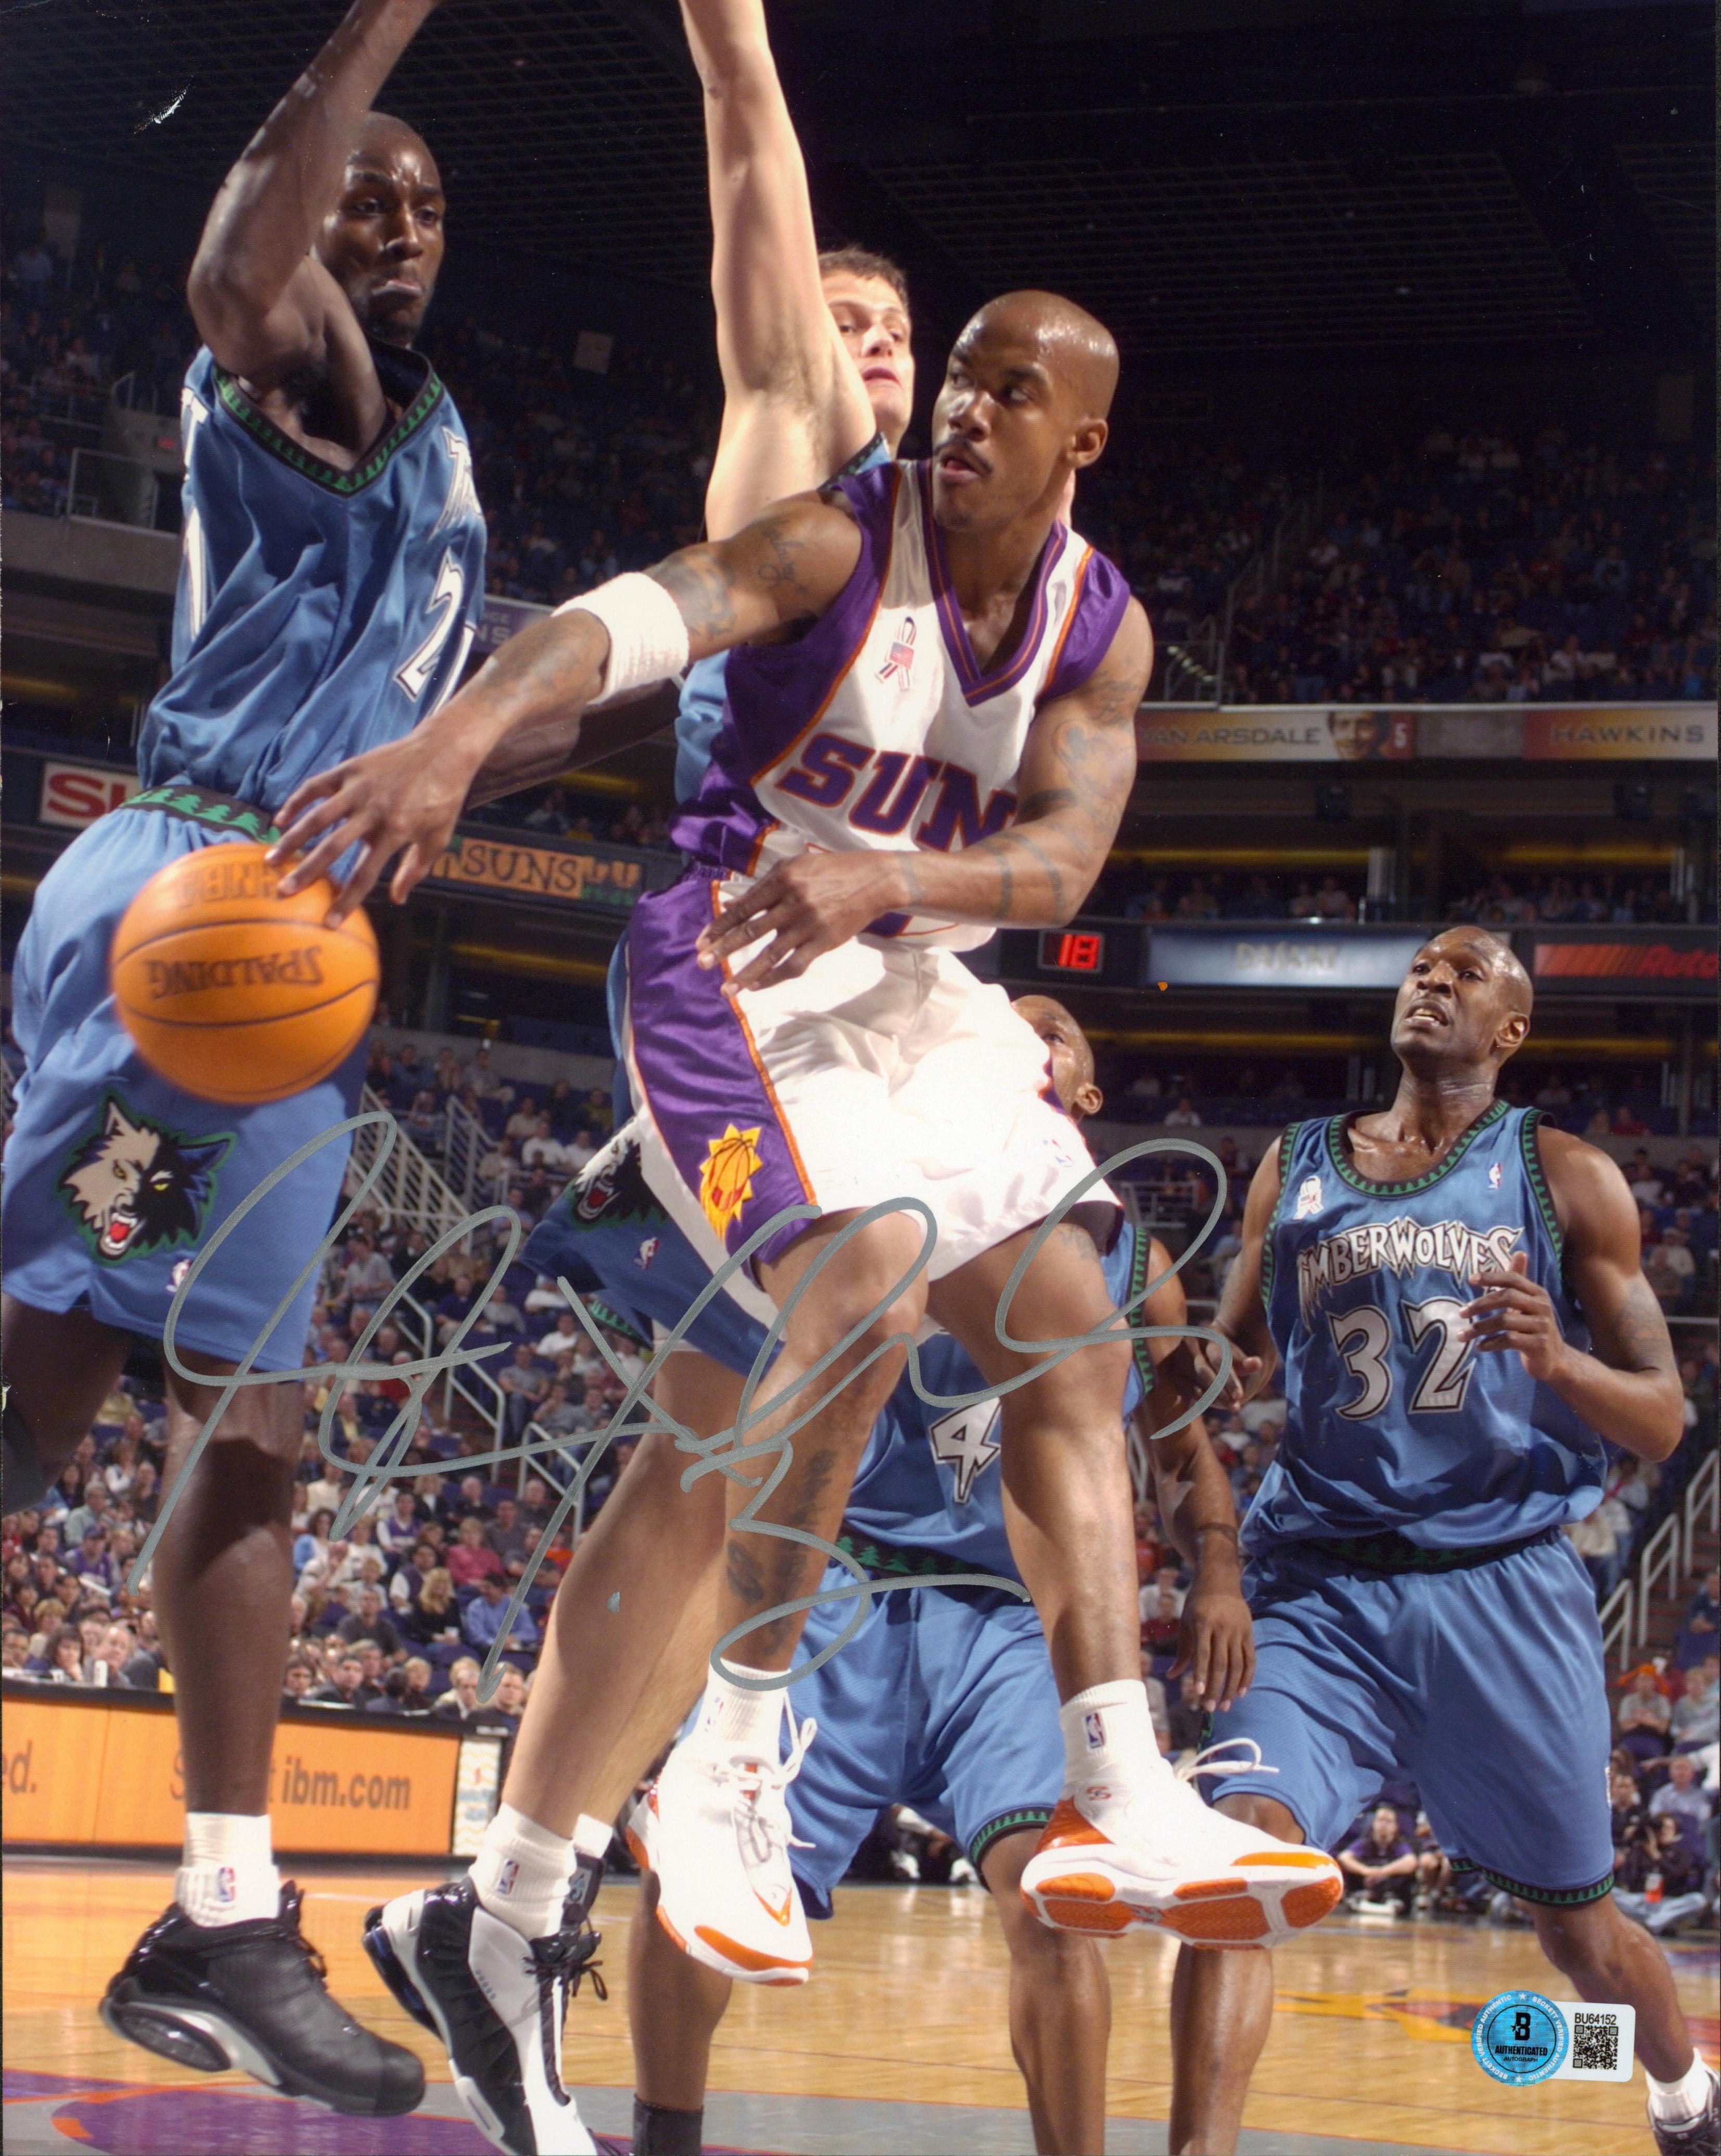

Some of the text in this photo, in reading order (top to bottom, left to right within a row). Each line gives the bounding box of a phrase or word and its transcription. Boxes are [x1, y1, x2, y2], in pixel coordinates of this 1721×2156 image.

[1196, 727, 1321, 745] ARSDALE
[1551, 725, 1706, 744] HAWKINS
[462, 842, 577, 893] SUNS
[143, 945, 325, 1001] SPALDING
[1058, 933, 1100, 969] 18
[1325, 1295, 1477, 1421] 32
[928, 1396, 1002, 1504] 4
[282, 1755, 412, 1810] ibm.com
[1476, 1994, 1512, 2080] BECKETT VERIFIED AUTHENTIC
[1528, 1996, 1564, 2081] BECKETT VERIFIED AUTHENTIC
[1575, 2012, 1617, 2025] BU64152
[1495, 2045, 1548, 2056] AUTHENTICATED
